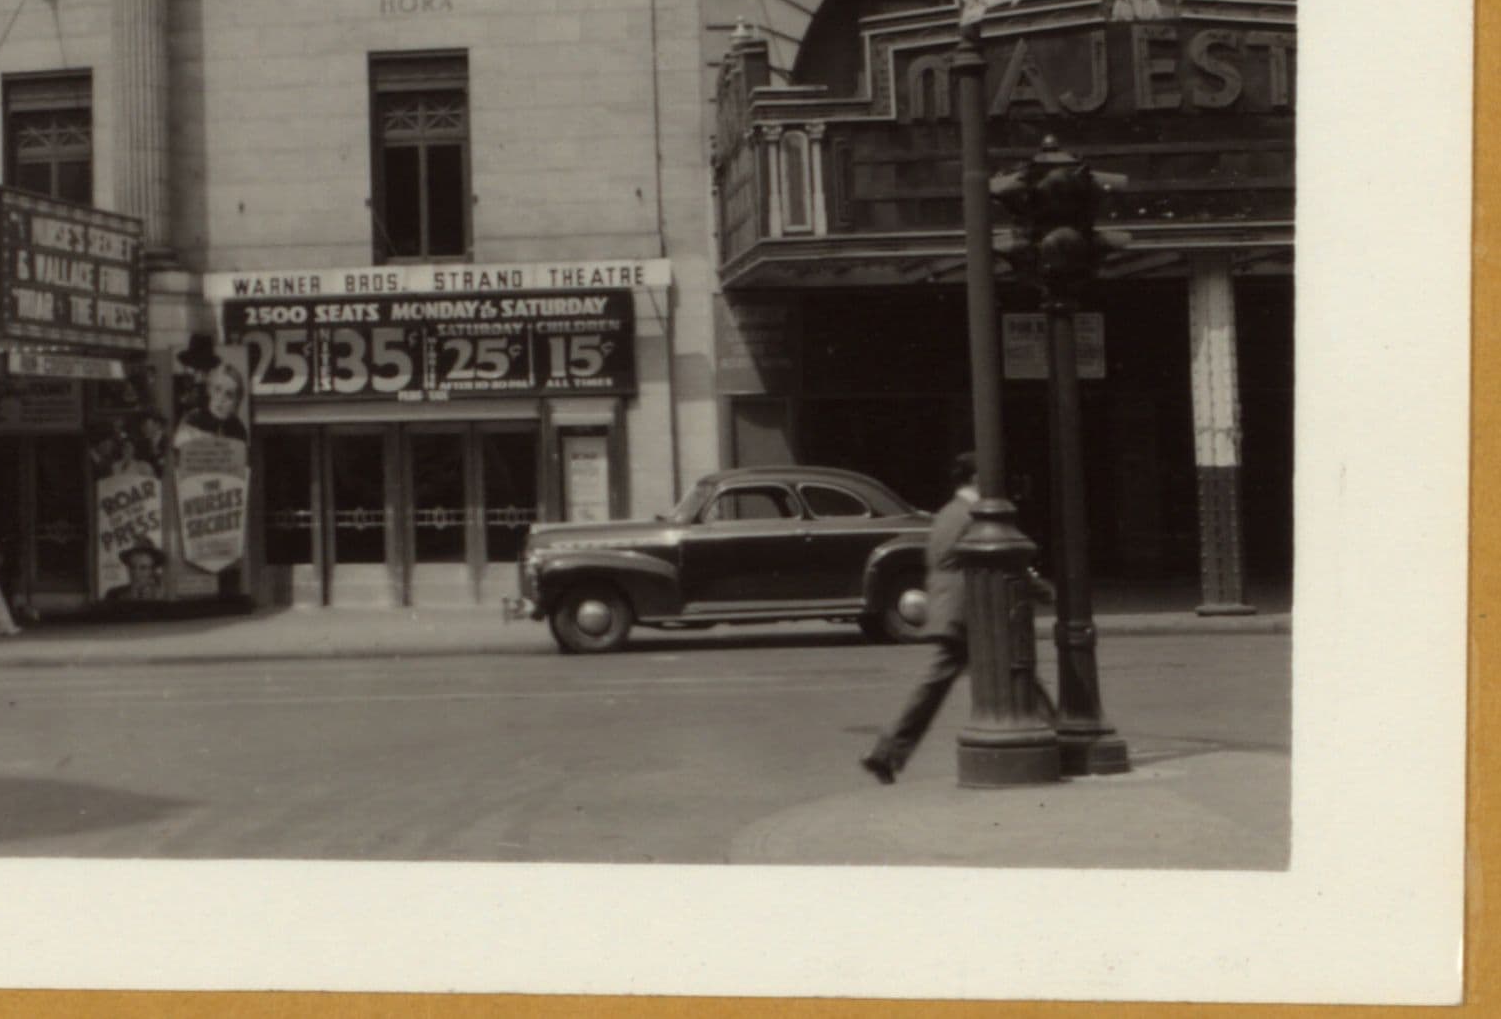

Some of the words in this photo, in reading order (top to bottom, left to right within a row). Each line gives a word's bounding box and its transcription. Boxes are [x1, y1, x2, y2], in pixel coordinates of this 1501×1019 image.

[233, 276, 321, 296] WARNER
[434, 270, 523, 291] STRAND
[549, 265, 645, 287] THEATRE
[245, 306, 307, 325] 2500
[314, 303, 380, 322] SEATS
[391, 298, 480, 321] MONDAY
[500, 296, 608, 318] SATURDAY
[435, 322, 524, 338] SATURDAY
[101, 480, 155, 516] ROAR
[101, 511, 160, 552] PRESS
